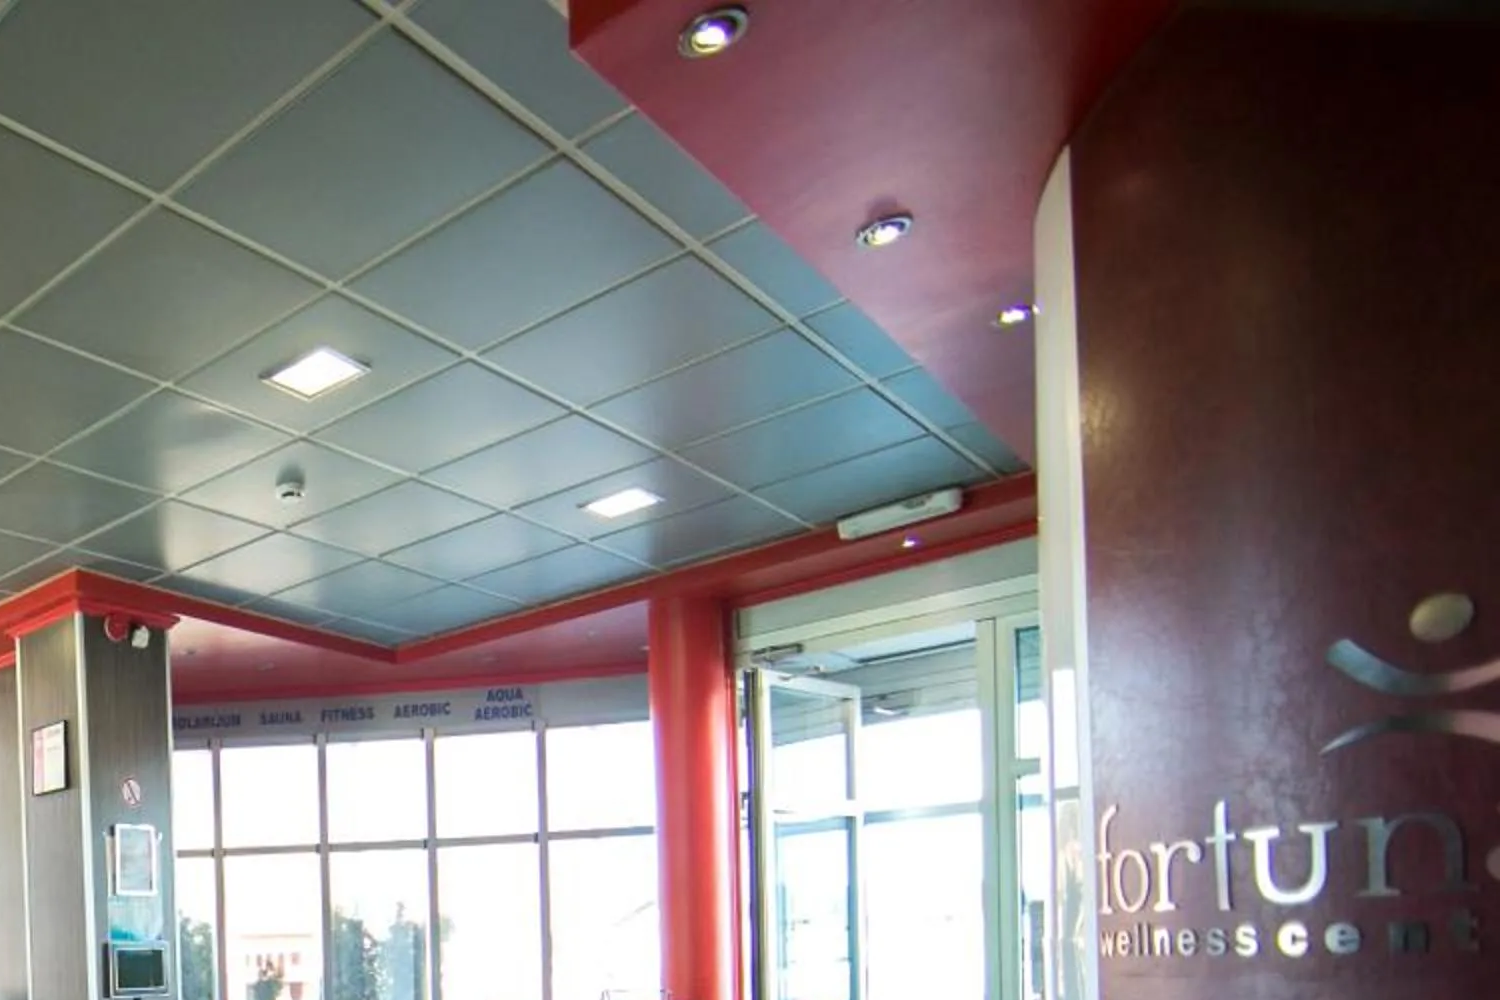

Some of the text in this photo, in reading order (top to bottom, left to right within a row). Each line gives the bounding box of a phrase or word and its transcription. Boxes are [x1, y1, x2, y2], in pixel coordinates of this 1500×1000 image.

[486, 688, 524, 702] AQUA
[320, 706, 375, 723] FITNESS
[393, 702, 452, 719] AEROBIC
[474, 703, 533, 721] AEROBIC
[1098, 799, 1500, 916] fortun
[1100, 921, 1259, 958] wellness
